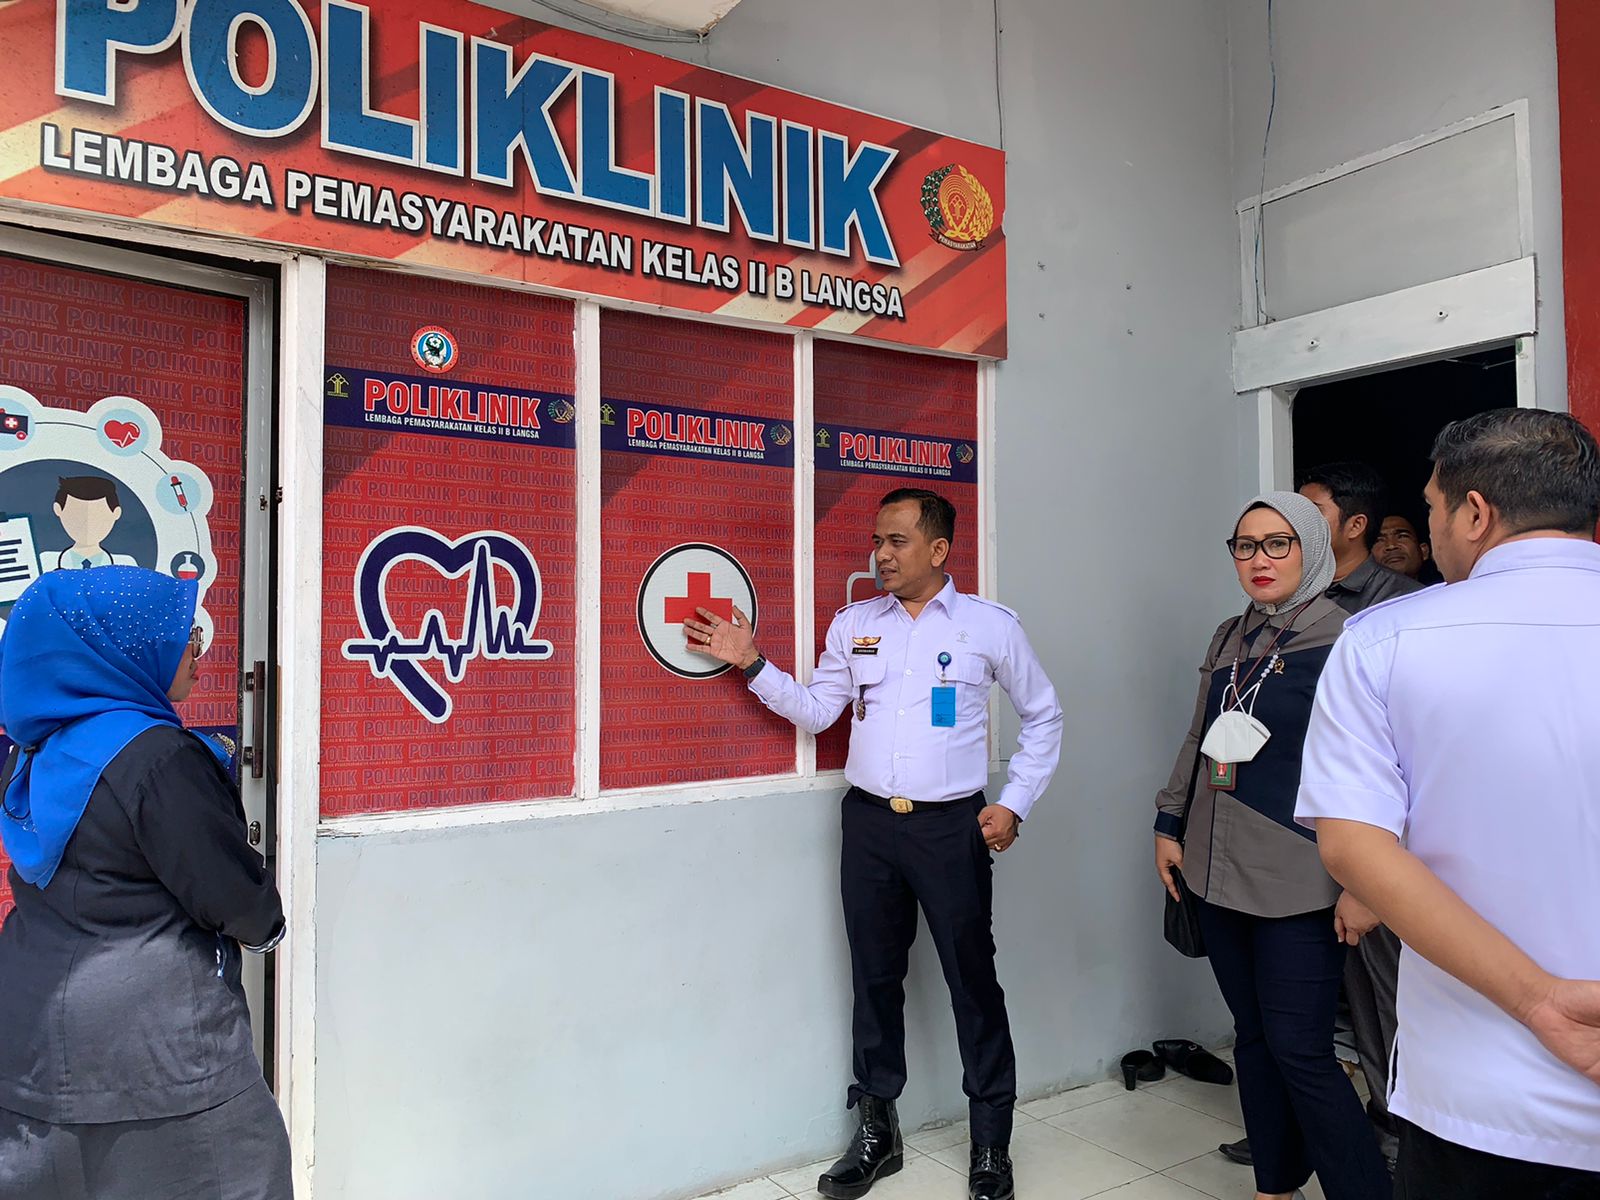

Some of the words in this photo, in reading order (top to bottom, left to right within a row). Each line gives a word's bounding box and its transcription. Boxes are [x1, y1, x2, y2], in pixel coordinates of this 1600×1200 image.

[55, 0, 900, 268] POLIKLINIK
[42, 124, 272, 204] LEMBAGA
[287, 171, 633, 270] PEMASYARAKATAN
[642, 243, 739, 289] KELAS
[748, 261, 766, 294] II
[776, 267, 794, 298] B
[801, 271, 904, 317] LANGSA
[67, 306, 184, 344] POLIKLINIK
[460, 306, 536, 329] POLIKLINIK
[0, 327, 123, 363] POLIKLINIK
[130, 346, 240, 380] POLIKLINIK
[501, 334, 574, 356] POLIKLINIK
[701, 342, 760, 362] POLIKLINIK
[459, 351, 535, 373] POLIKLINIK
[65, 367, 183, 401] POLIKLINIK
[734, 367, 791, 386] POLIKLINIK
[701, 383, 760, 401] POLIKLINIK
[364, 378, 541, 429] POLIKLINIK
[365, 412, 402, 426] LEMBAGA
[404, 417, 472, 432] PEMASYARAKATAN
[474, 423, 497, 435] KELAS
[512, 428, 539, 439] LANGSA
[627, 408, 765, 450] POLIKLINIK
[369, 435, 451, 455] POLIKLINIK
[458, 442, 534, 461] POLIKLINIK
[628, 438, 658, 449] LEMBAGA
[839, 431, 952, 469] POLIKLINIK
[414, 462, 493, 480] POLIKLINIK
[500, 468, 573, 486] POLIKLINIK
[631, 457, 695, 474] POLIKLINIK
[701, 463, 760, 479] POLIKLINIK
[368, 482, 450, 501] POLIKLINIK
[457, 488, 534, 505] POLIKLINIK
[667, 481, 728, 497] POLIKLINIK
[734, 486, 791, 501] POLIKLINIK
[413, 508, 493, 526] POLIKLINIK
[499, 513, 573, 529] POLIKLINIK
[631, 499, 695, 514] POLIKLINIK
[701, 503, 761, 518] POLIKLINIK
[667, 522, 729, 536] POLIKLINIK
[734, 525, 792, 540] POLIKLINIK
[463, 671, 532, 685] OLIKLINIK
[497, 692, 571, 707] POLIKLINIK
[667, 685, 729, 698] POLIKLINIK
[632, 706, 696, 720] POLIKLINIK
[363, 719, 447, 736] POLIKLINIK
[454, 716, 531, 732] POLIKLINIK
[667, 725, 729, 739] POLIKLINIK
[409, 740, 489, 758] POLIKLINIK
[496, 736, 571, 753] POLIKLINIK
[632, 747, 696, 763] POLIKLINIK
[702, 743, 761, 758] POLIKLINIK
[363, 765, 446, 784] POLIKLINIK
[453, 761, 530, 778] POLIKLINIK
[667, 765, 729, 781] POLIKLINIK
[408, 786, 489, 805] POLIKLINIK
